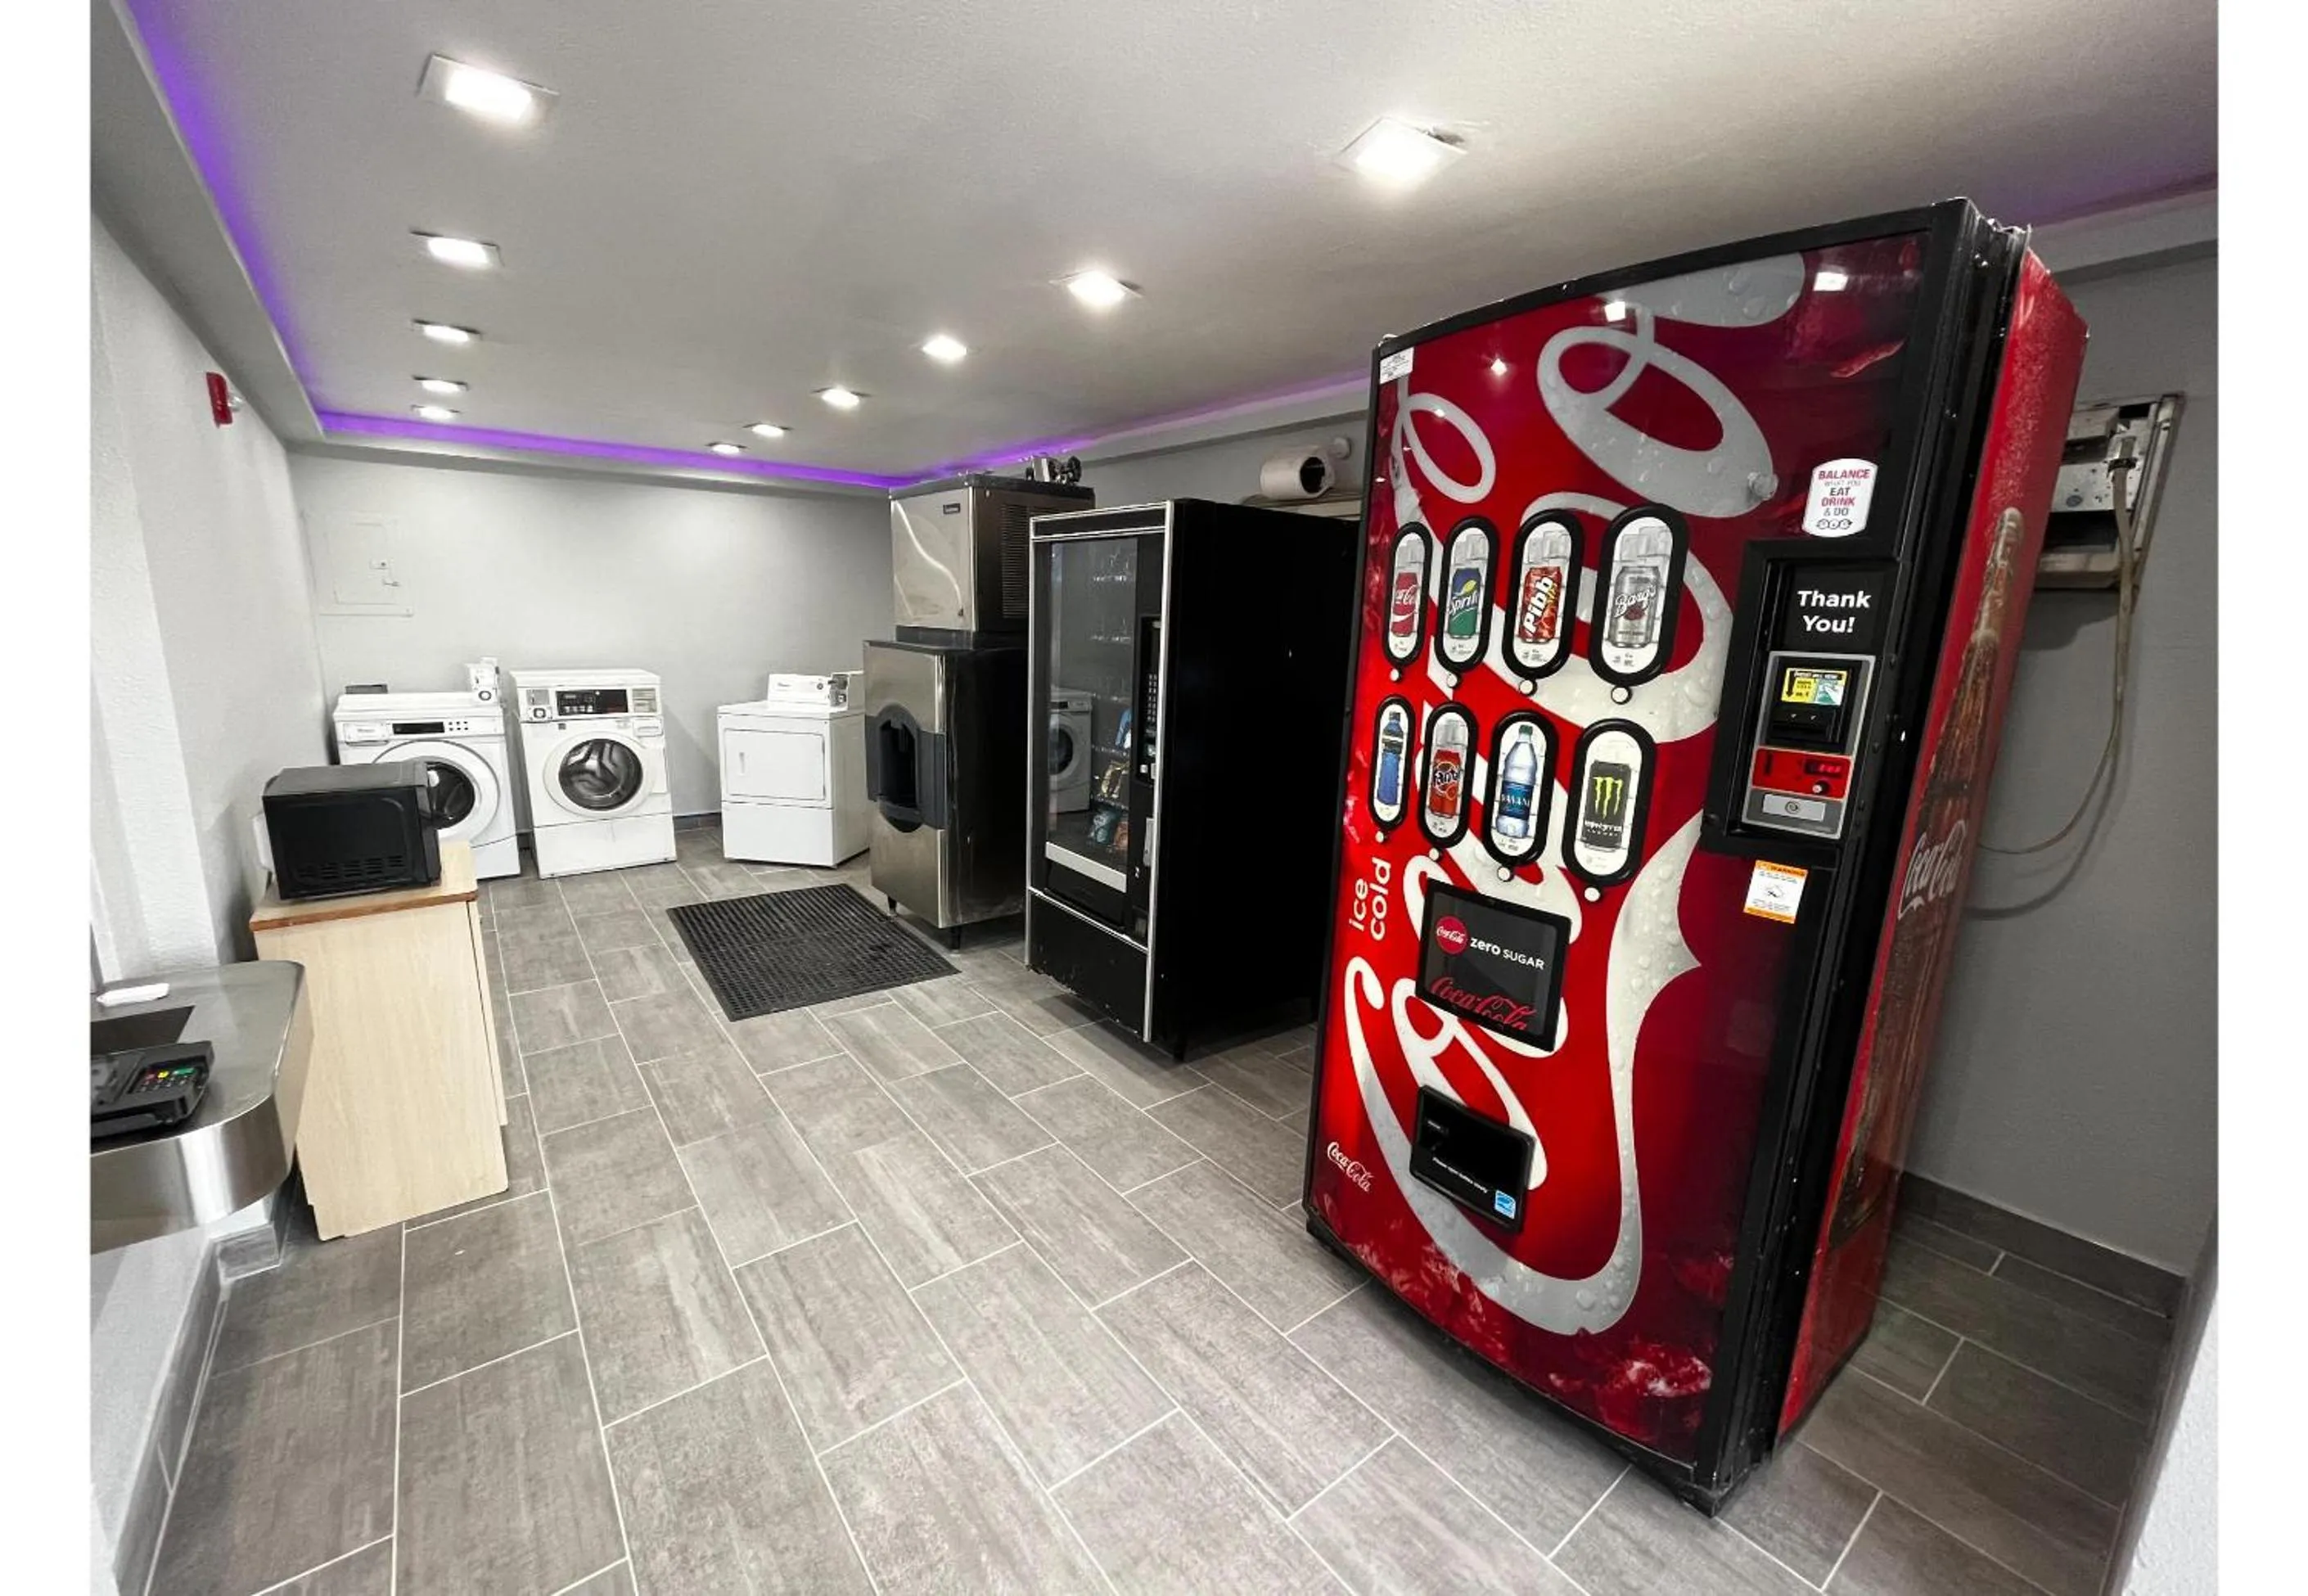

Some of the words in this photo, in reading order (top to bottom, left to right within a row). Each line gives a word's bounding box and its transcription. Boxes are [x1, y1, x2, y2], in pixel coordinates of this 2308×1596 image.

[1818, 469, 1870, 480] BALANCE
[1830, 487, 1850, 496] EAT
[1821, 497, 1855, 507] DRINK
[1833, 507, 1849, 516] DO
[1522, 575, 1553, 634] Pibb
[1797, 589, 1872, 608] Thank
[1802, 615, 1855, 633] You!
[1349, 878, 1368, 931] ice
[1370, 857, 1391, 940] cold
[1470, 937, 1501, 956] zero
[1503, 949, 1544, 971] SUGAR
